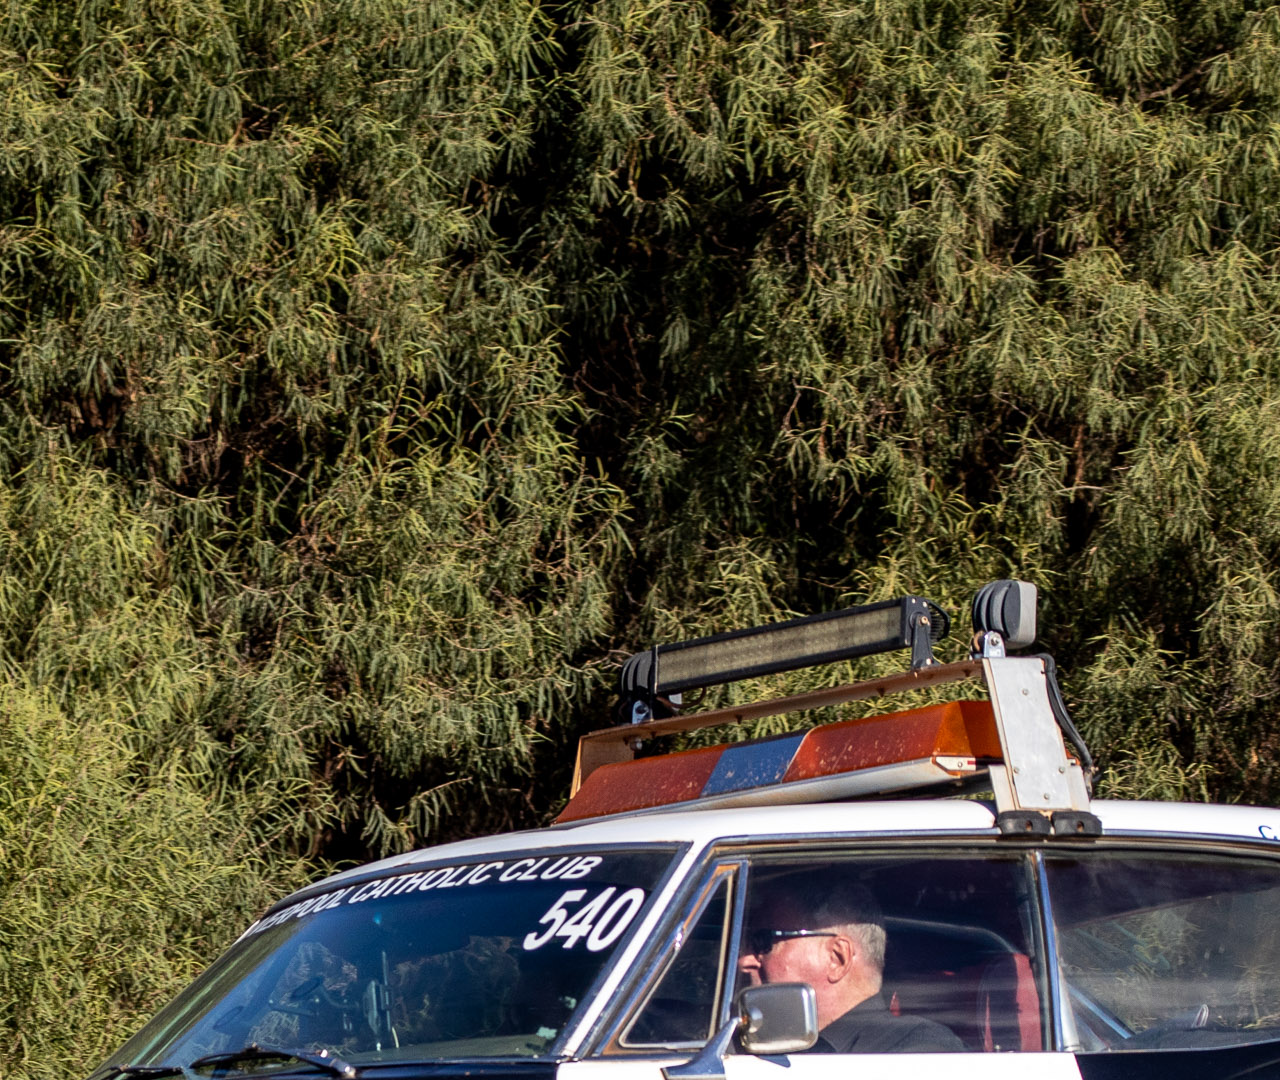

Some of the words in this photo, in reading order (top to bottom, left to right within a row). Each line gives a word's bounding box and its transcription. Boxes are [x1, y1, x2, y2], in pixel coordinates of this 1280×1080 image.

[348, 861, 506, 904] CATHOLIC
[499, 856, 604, 883] CLUB
[523, 886, 646, 952] 540
